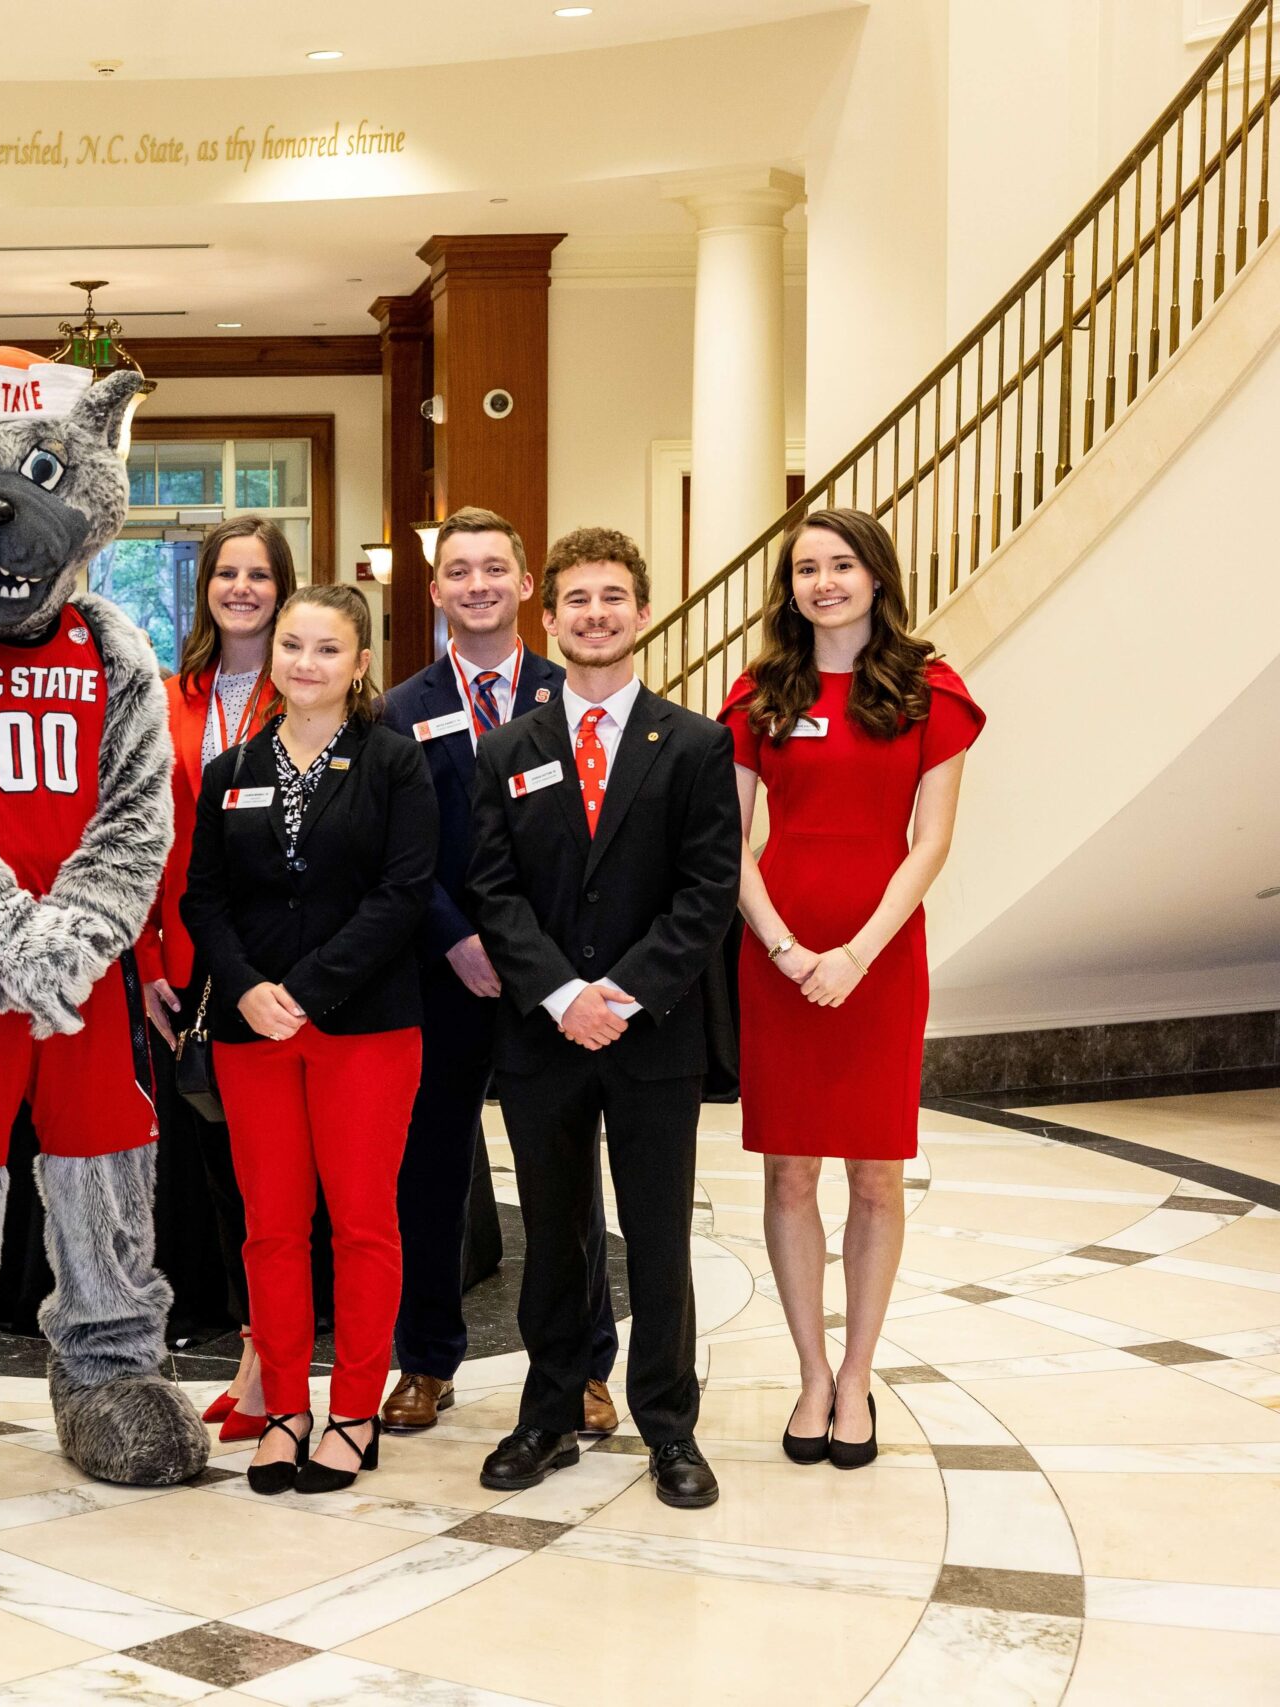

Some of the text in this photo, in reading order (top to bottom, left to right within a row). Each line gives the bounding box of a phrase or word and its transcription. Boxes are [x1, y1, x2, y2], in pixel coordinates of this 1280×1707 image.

[76, 133, 128, 165] N.C.
[134, 133, 189, 166] State,
[197, 139, 219, 162] as
[225, 126, 256, 173] thy
[261, 121, 340, 160] honored
[346, 119, 406, 156] shrine
[10, 666, 99, 703] STATE
